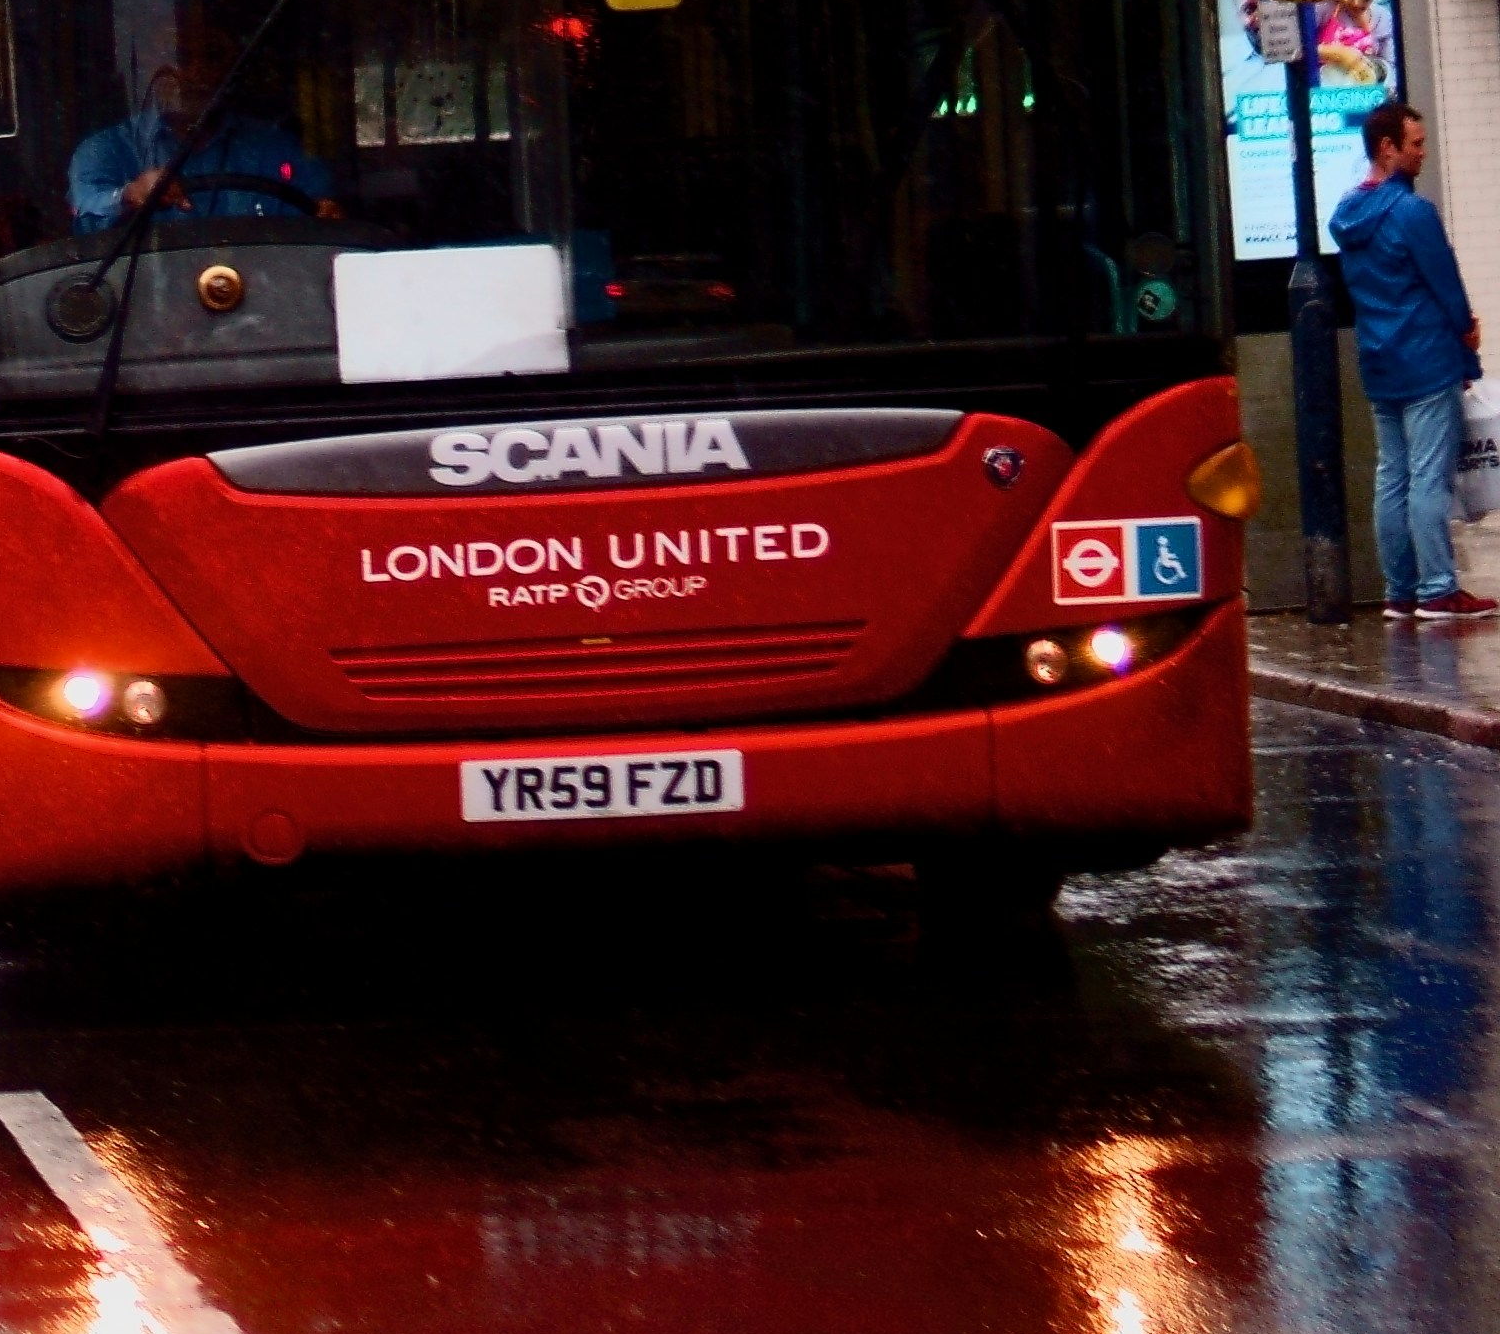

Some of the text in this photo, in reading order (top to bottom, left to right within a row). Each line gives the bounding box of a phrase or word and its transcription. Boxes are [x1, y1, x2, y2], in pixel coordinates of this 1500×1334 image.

[427, 417, 752, 486] SCANIA
[360, 522, 831, 584] LONDON UNITED
[488, 574, 710, 608] RATP GROUP
[481, 758, 723, 814] YR59 FZD
